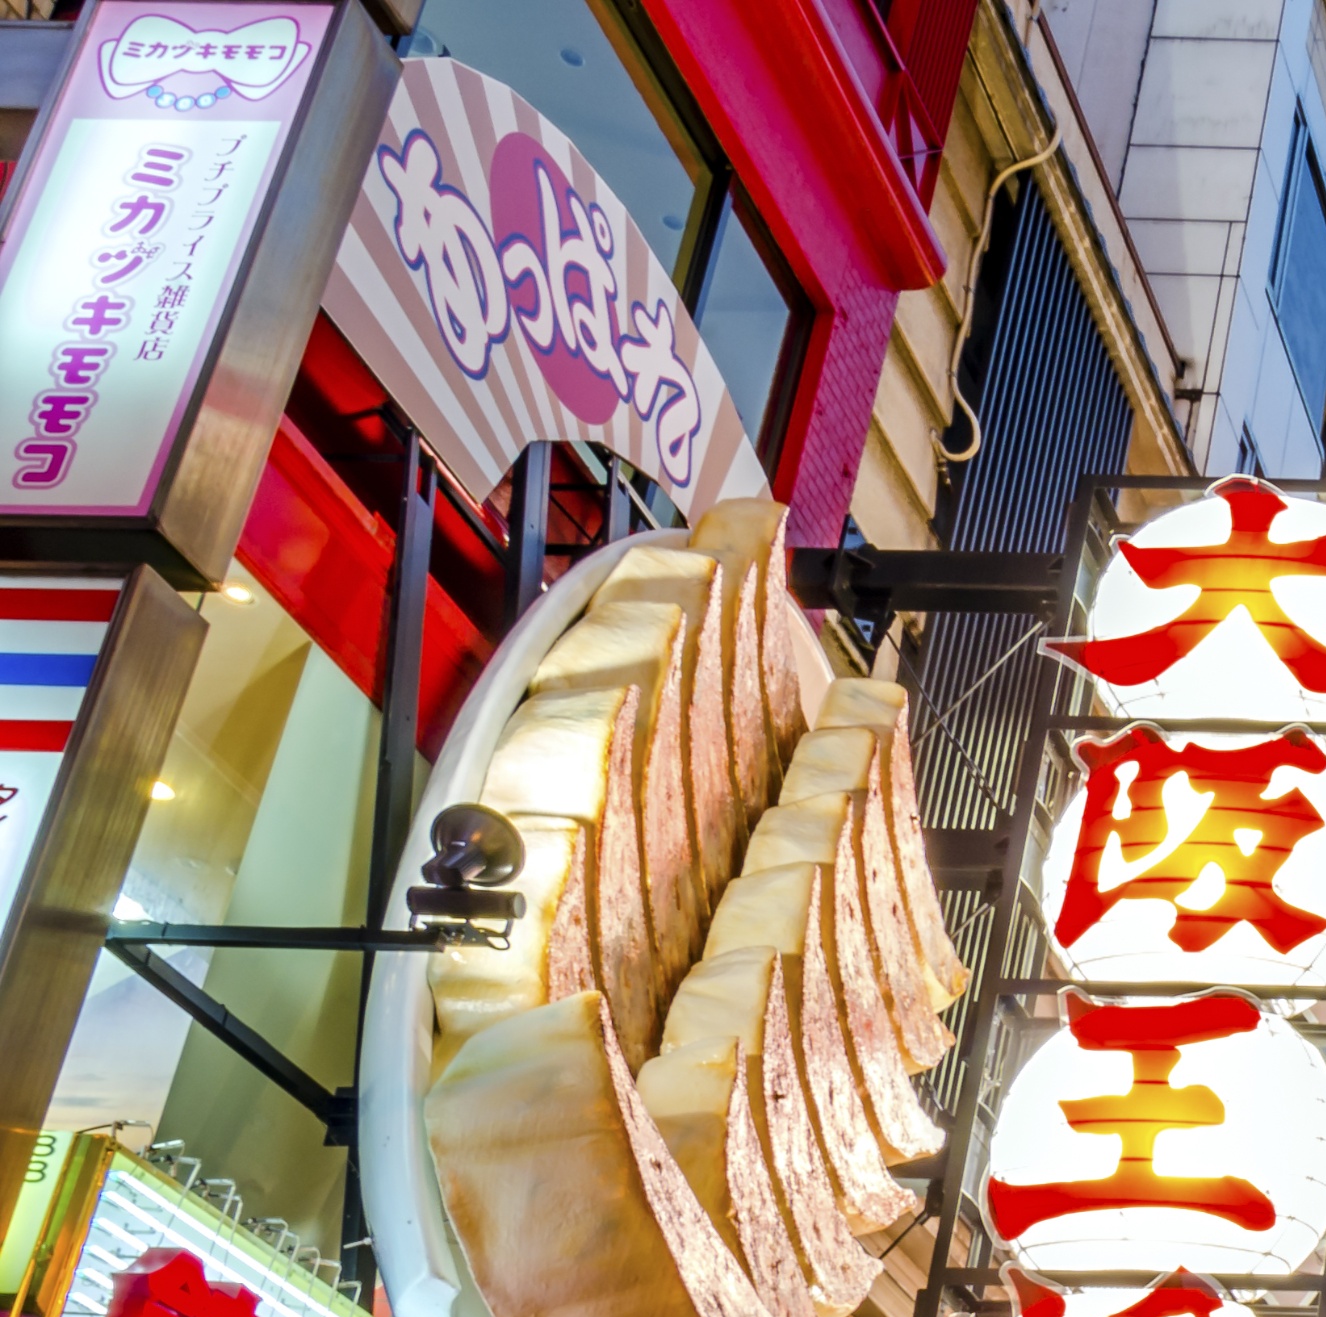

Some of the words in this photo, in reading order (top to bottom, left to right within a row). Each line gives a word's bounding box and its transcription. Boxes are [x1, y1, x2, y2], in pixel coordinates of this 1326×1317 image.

[133, 133, 246, 363] プチプライス雑貨店
